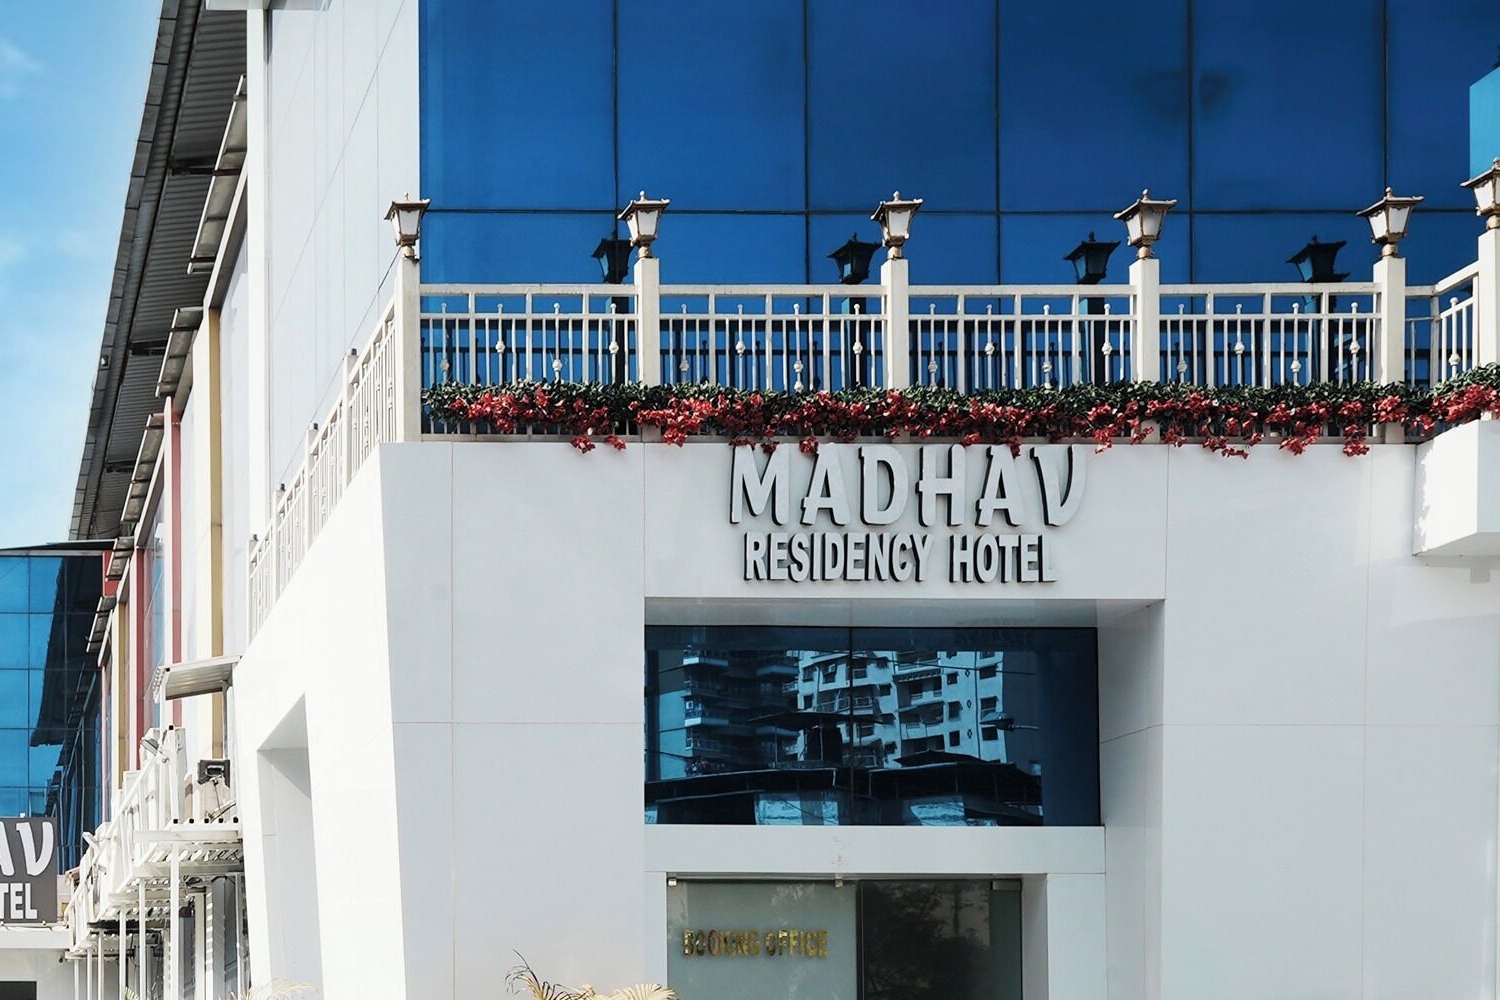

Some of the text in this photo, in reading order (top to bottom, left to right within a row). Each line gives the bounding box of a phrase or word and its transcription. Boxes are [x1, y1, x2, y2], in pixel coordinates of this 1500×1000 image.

[729, 443, 1087, 527] MADHAV
[744, 532, 1060, 584] RESIDENCY HOTEL
[764, 929, 829, 958] OFFICE
